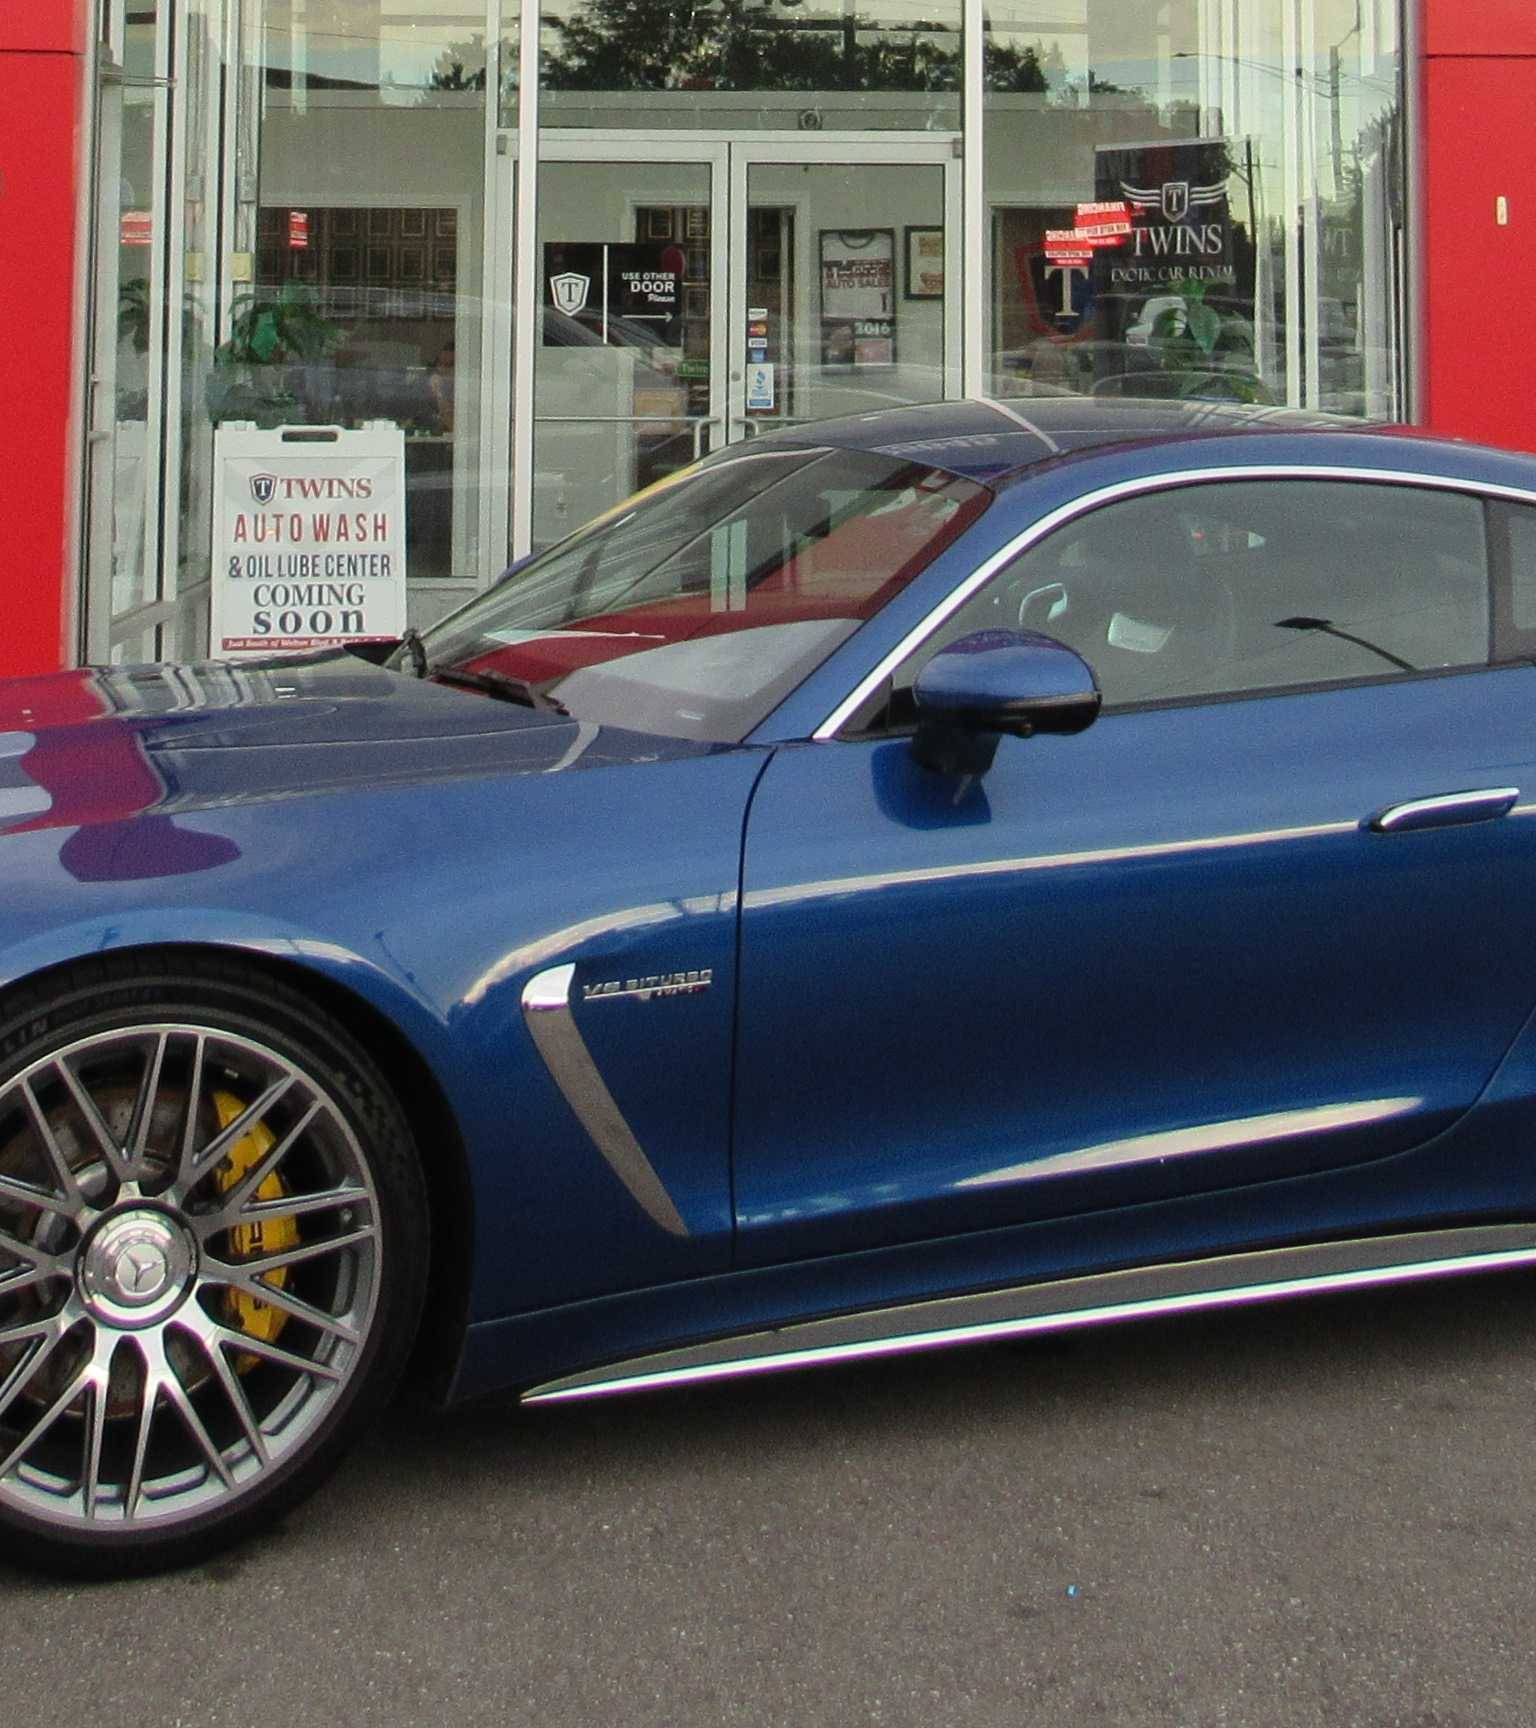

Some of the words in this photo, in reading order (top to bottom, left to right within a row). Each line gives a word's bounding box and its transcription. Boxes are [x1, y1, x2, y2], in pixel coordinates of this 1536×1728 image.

[1168, 188, 1181, 211] T
[1131, 224, 1223, 257] TWINS
[622, 272, 641, 280] USE
[643, 272, 675, 280] OTHER
[1158, 265, 1185, 281] CAR
[561, 282, 579, 303] T
[630, 281, 675, 293] DOOR
[1044, 266, 1089, 316] T
[854, 322, 891, 335] 2016
[256, 479, 271, 497] T
[279, 477, 373, 499] TWINS
[233, 513, 303, 543] AUTO
[312, 513, 387, 542] WASH
[228, 555, 242, 578] &
[246, 555, 273, 578] OIL
[277, 554, 321, 577] LUBE
[325, 554, 392, 577] CENTER
[253, 583, 366, 607] COMING
[625, 968, 713, 991] BITURBO
